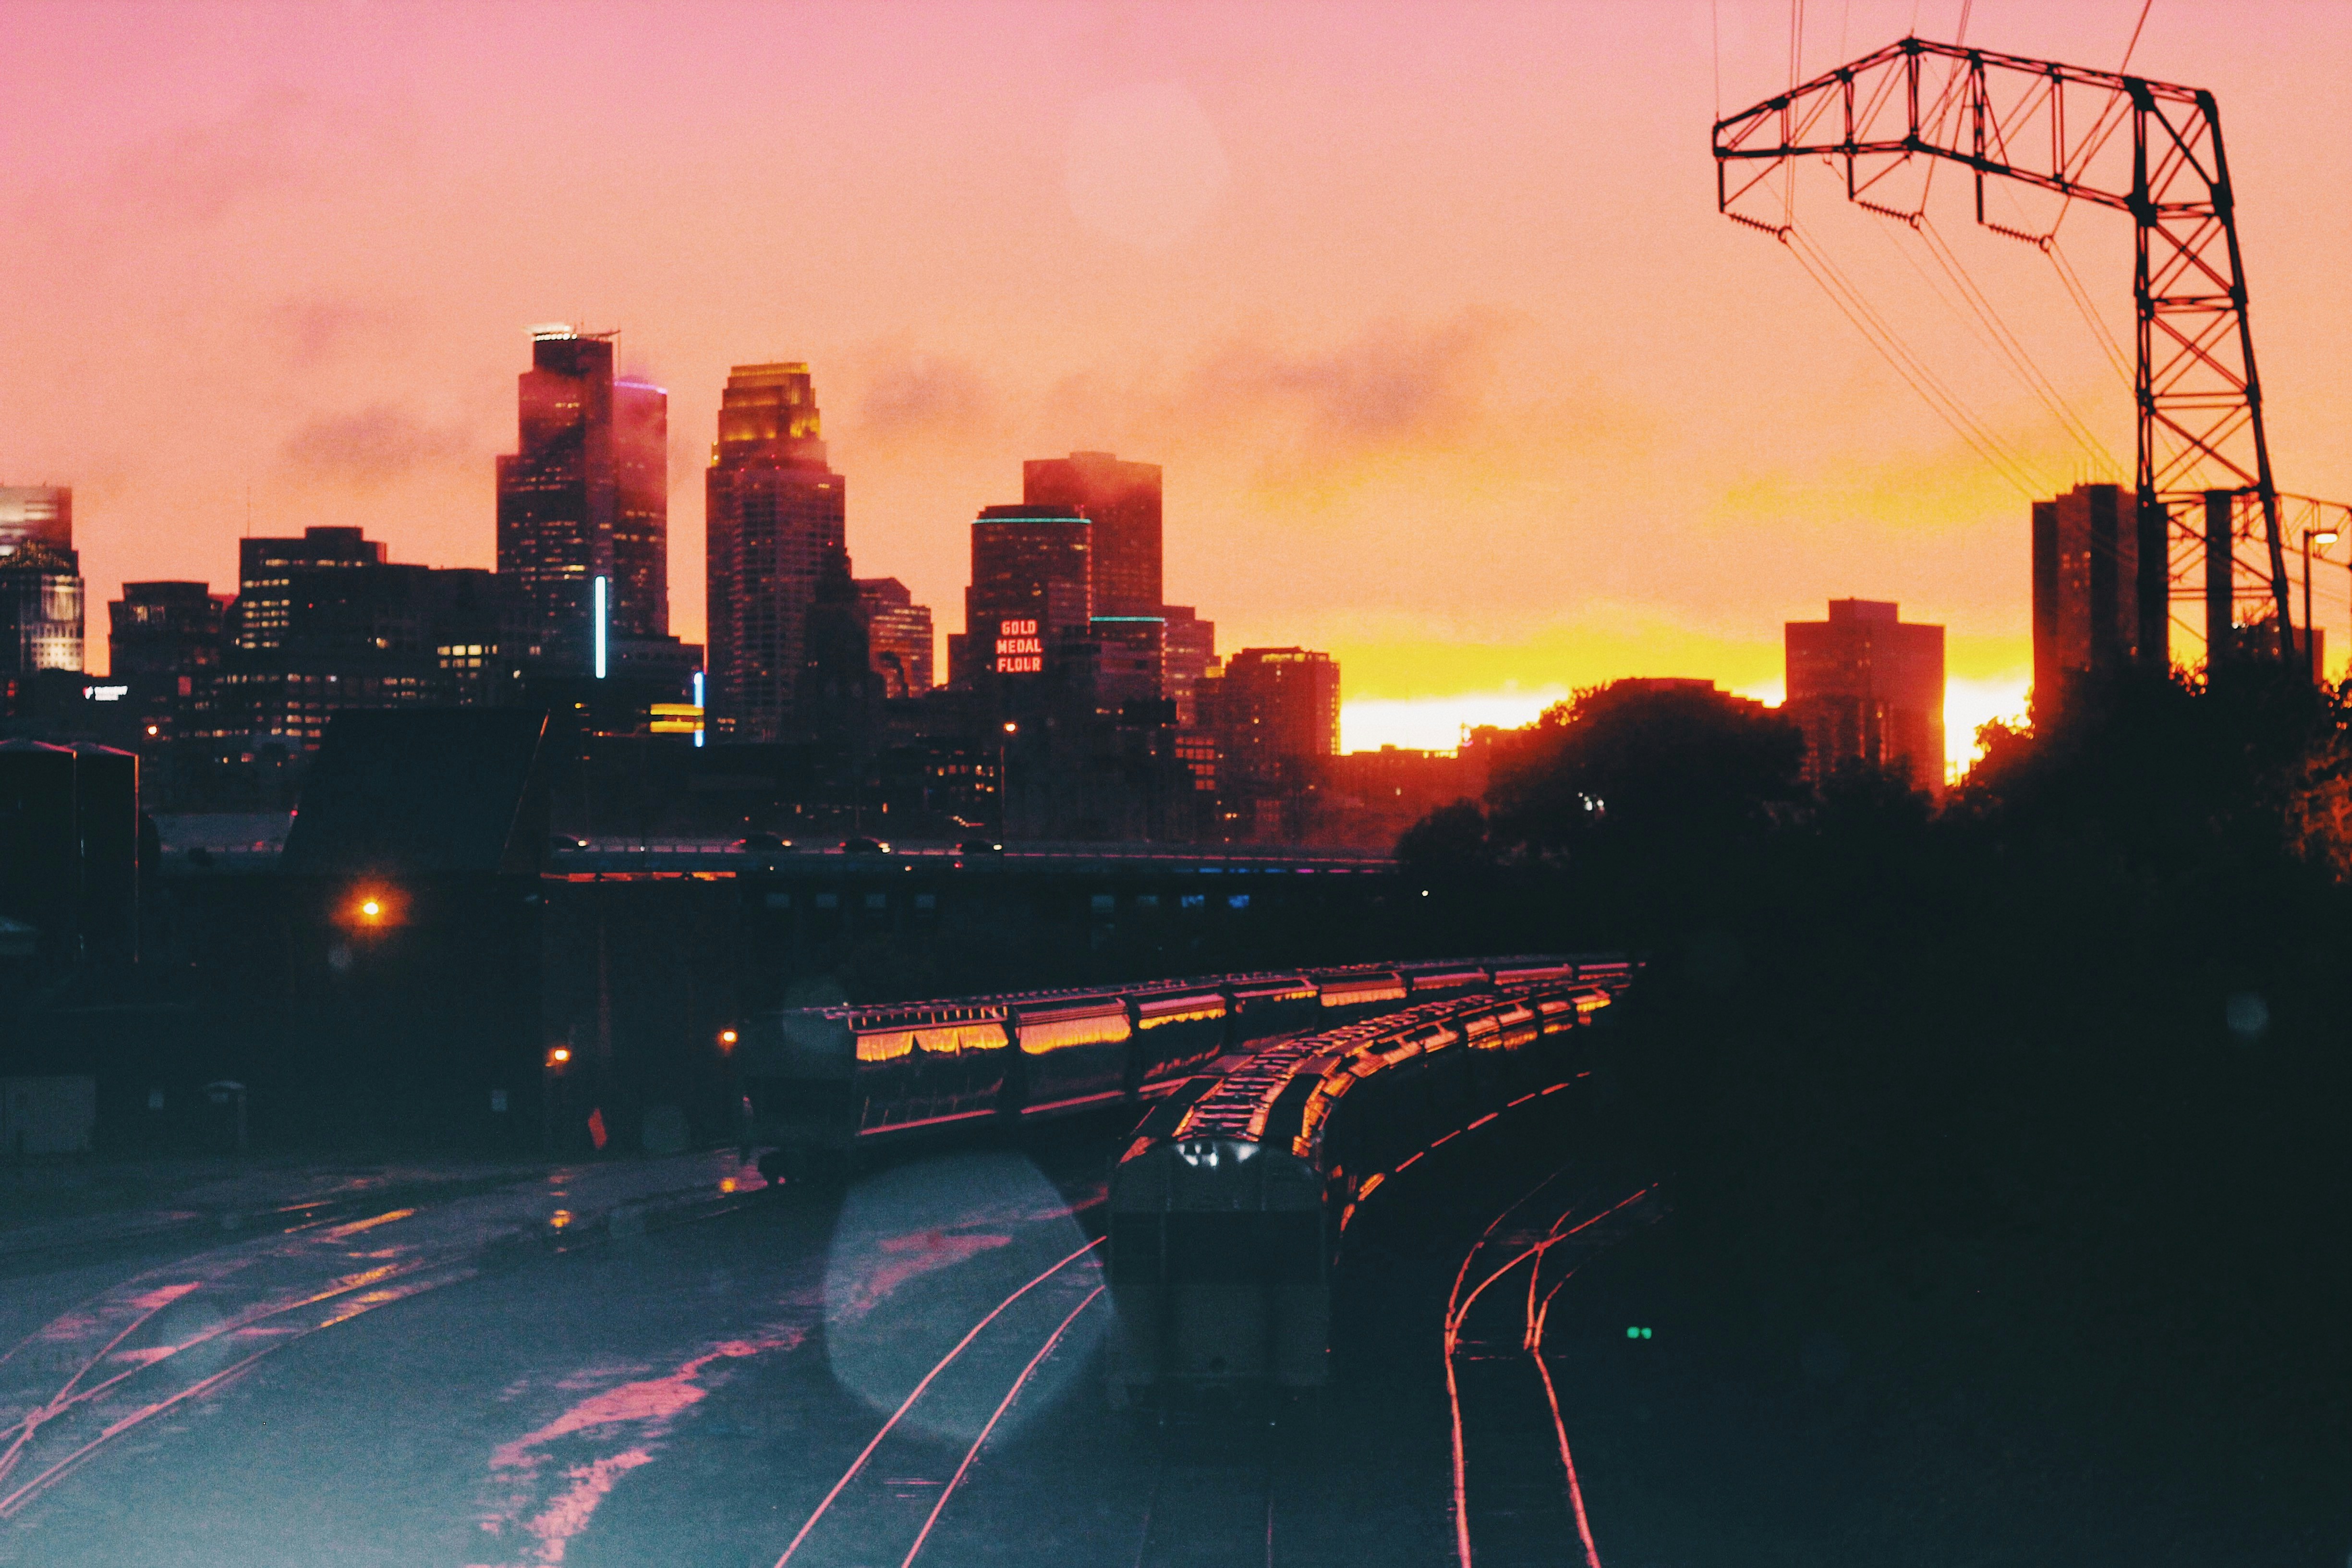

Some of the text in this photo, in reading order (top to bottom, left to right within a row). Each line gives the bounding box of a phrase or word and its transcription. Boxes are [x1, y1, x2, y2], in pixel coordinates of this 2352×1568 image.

[1001, 620, 1037, 635] GOLD
[996, 638, 1043, 654] MEDAL
[997, 656, 1042, 672] FLOUR
